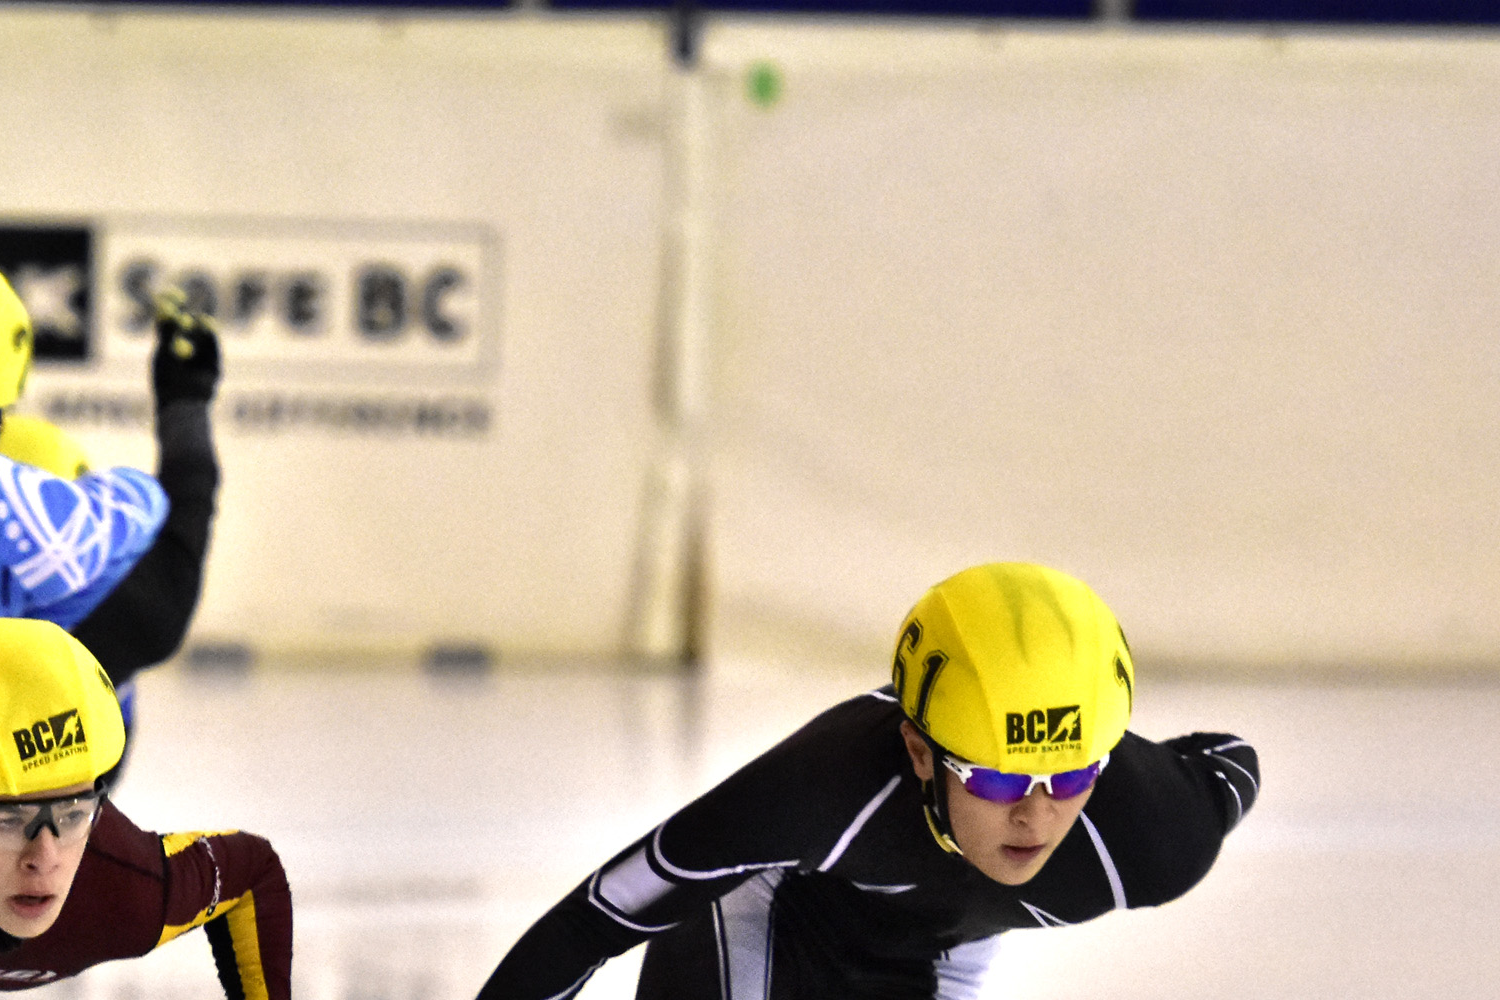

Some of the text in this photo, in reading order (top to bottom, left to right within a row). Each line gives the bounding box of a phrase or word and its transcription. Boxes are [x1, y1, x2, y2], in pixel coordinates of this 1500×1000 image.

[357, 261, 470, 341] BC
[13, 720, 54, 762] BC
[1006, 709, 1045, 745] BC
[22, 745, 88, 773] SPEED SKATING
[1007, 742, 1082, 755] SPEED SKATING
